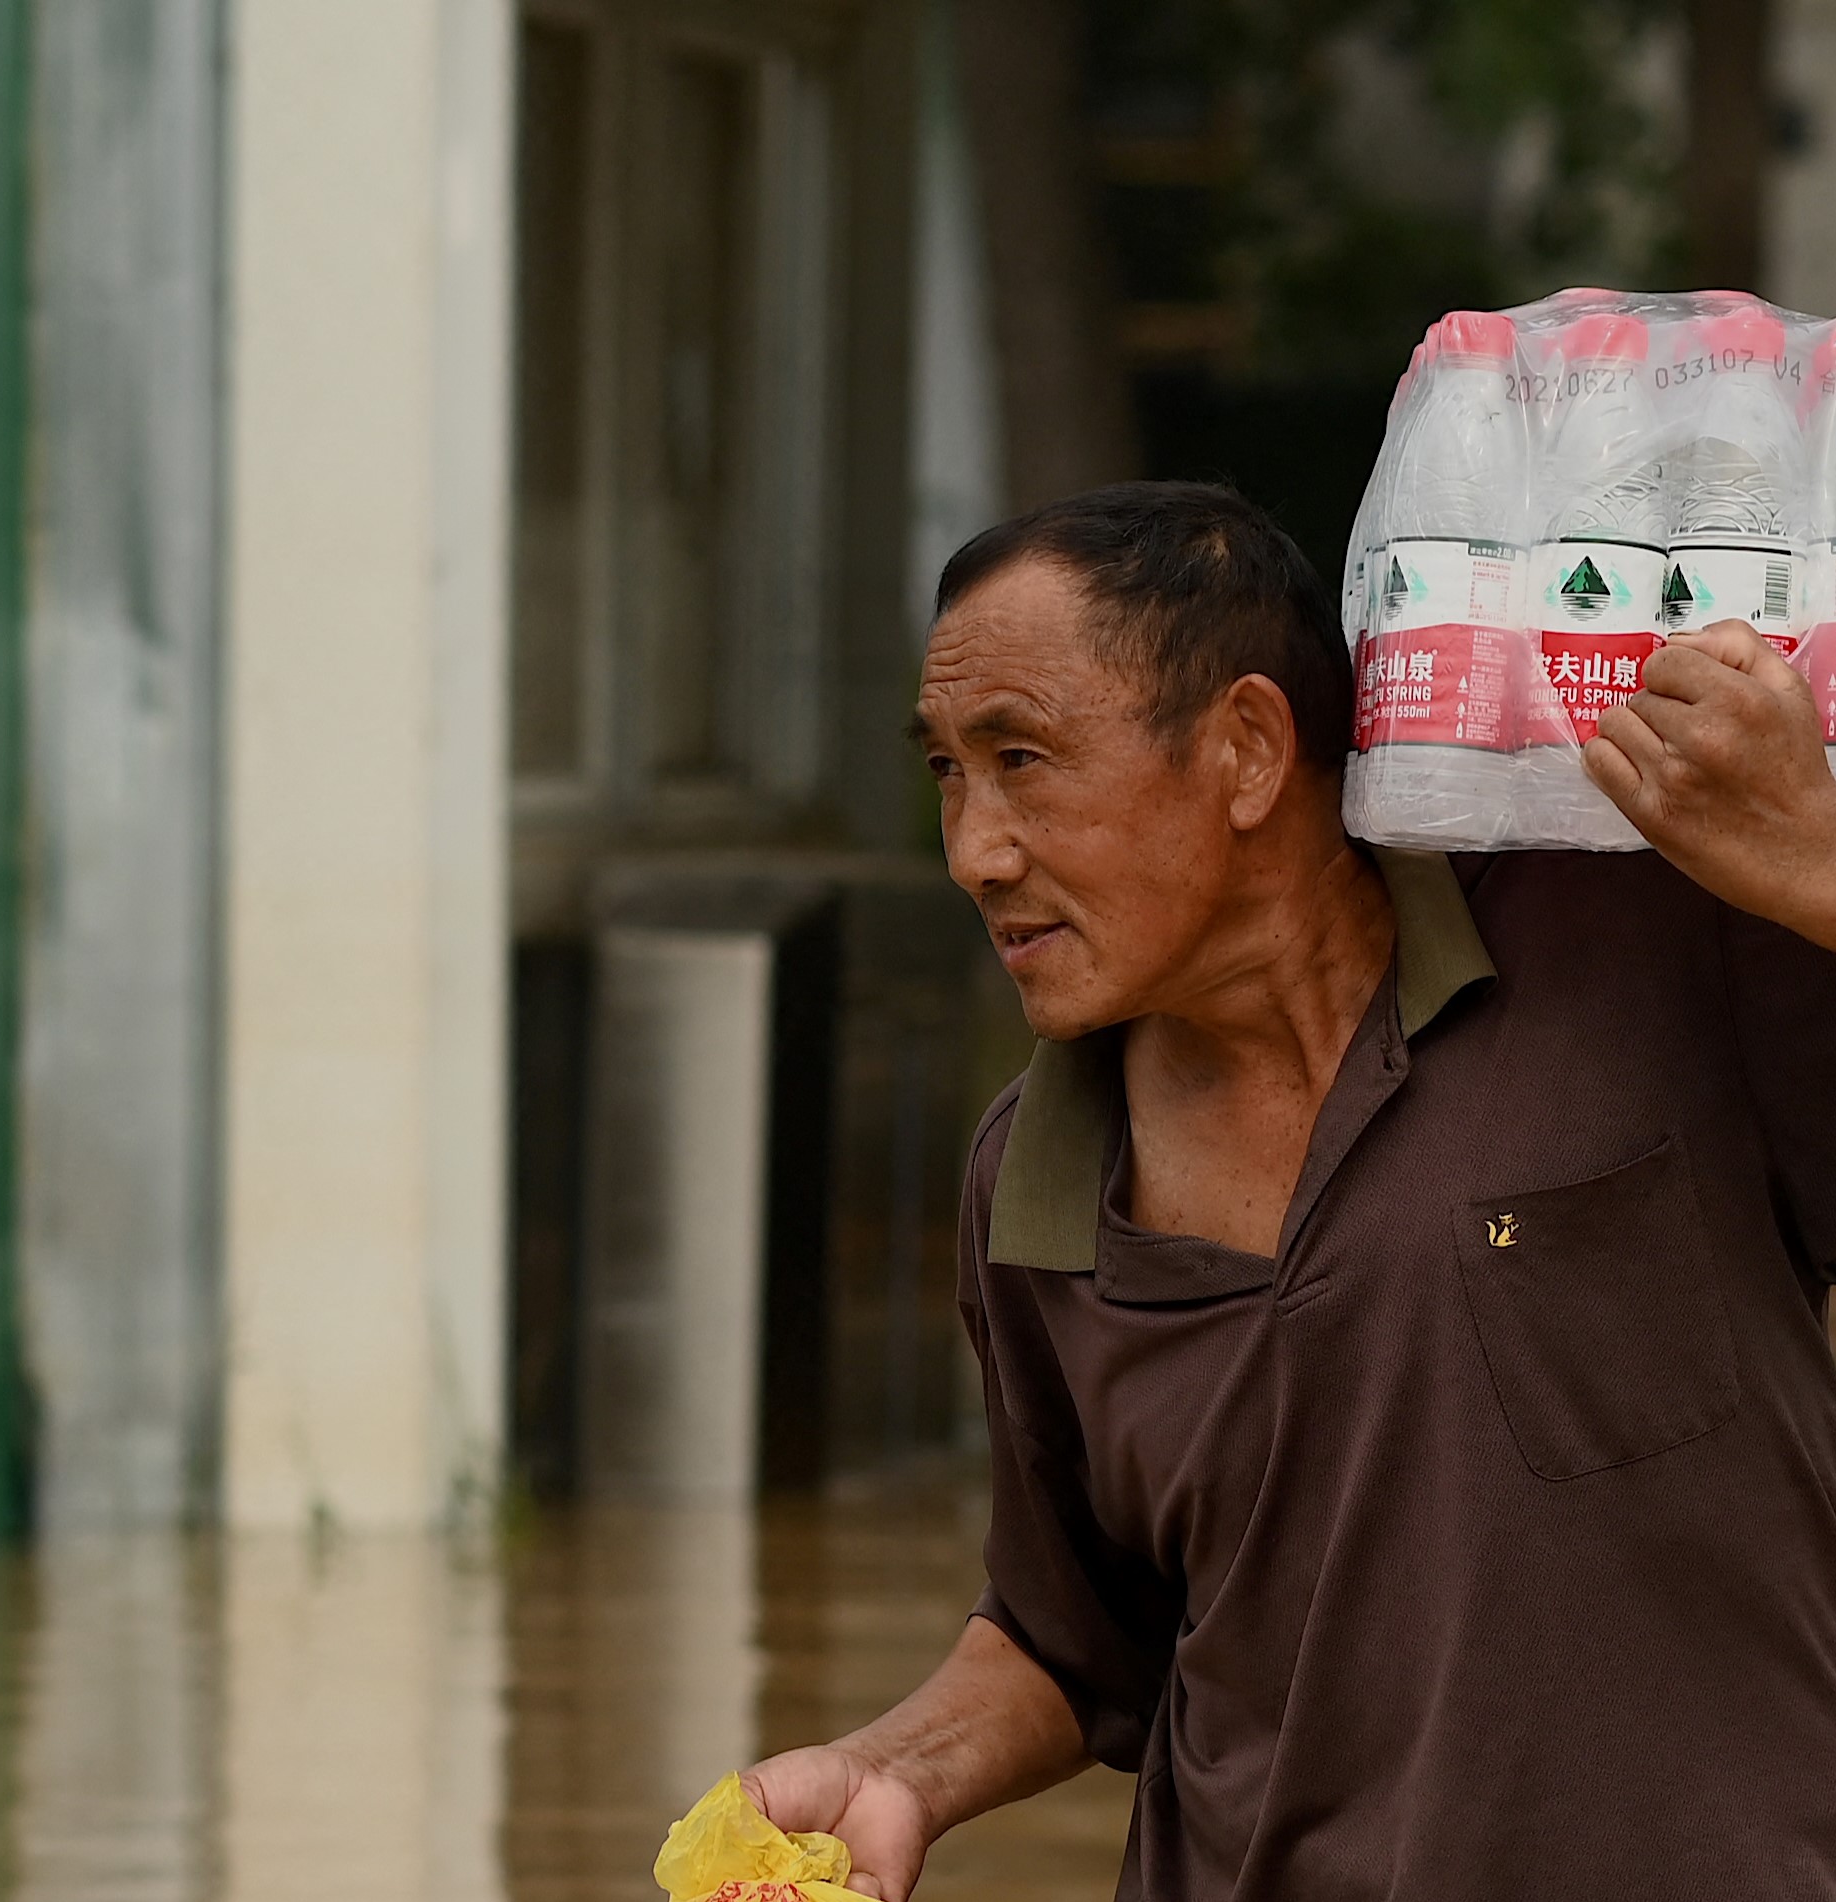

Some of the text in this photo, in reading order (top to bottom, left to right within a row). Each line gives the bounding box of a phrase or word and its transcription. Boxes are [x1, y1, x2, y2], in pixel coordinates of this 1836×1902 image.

[1504, 367, 1634, 404] 20210627
[1654, 347, 1755, 391] 033107
[1774, 354, 1802, 386] V4
[1530, 650, 1638, 689] 农夫山泉
